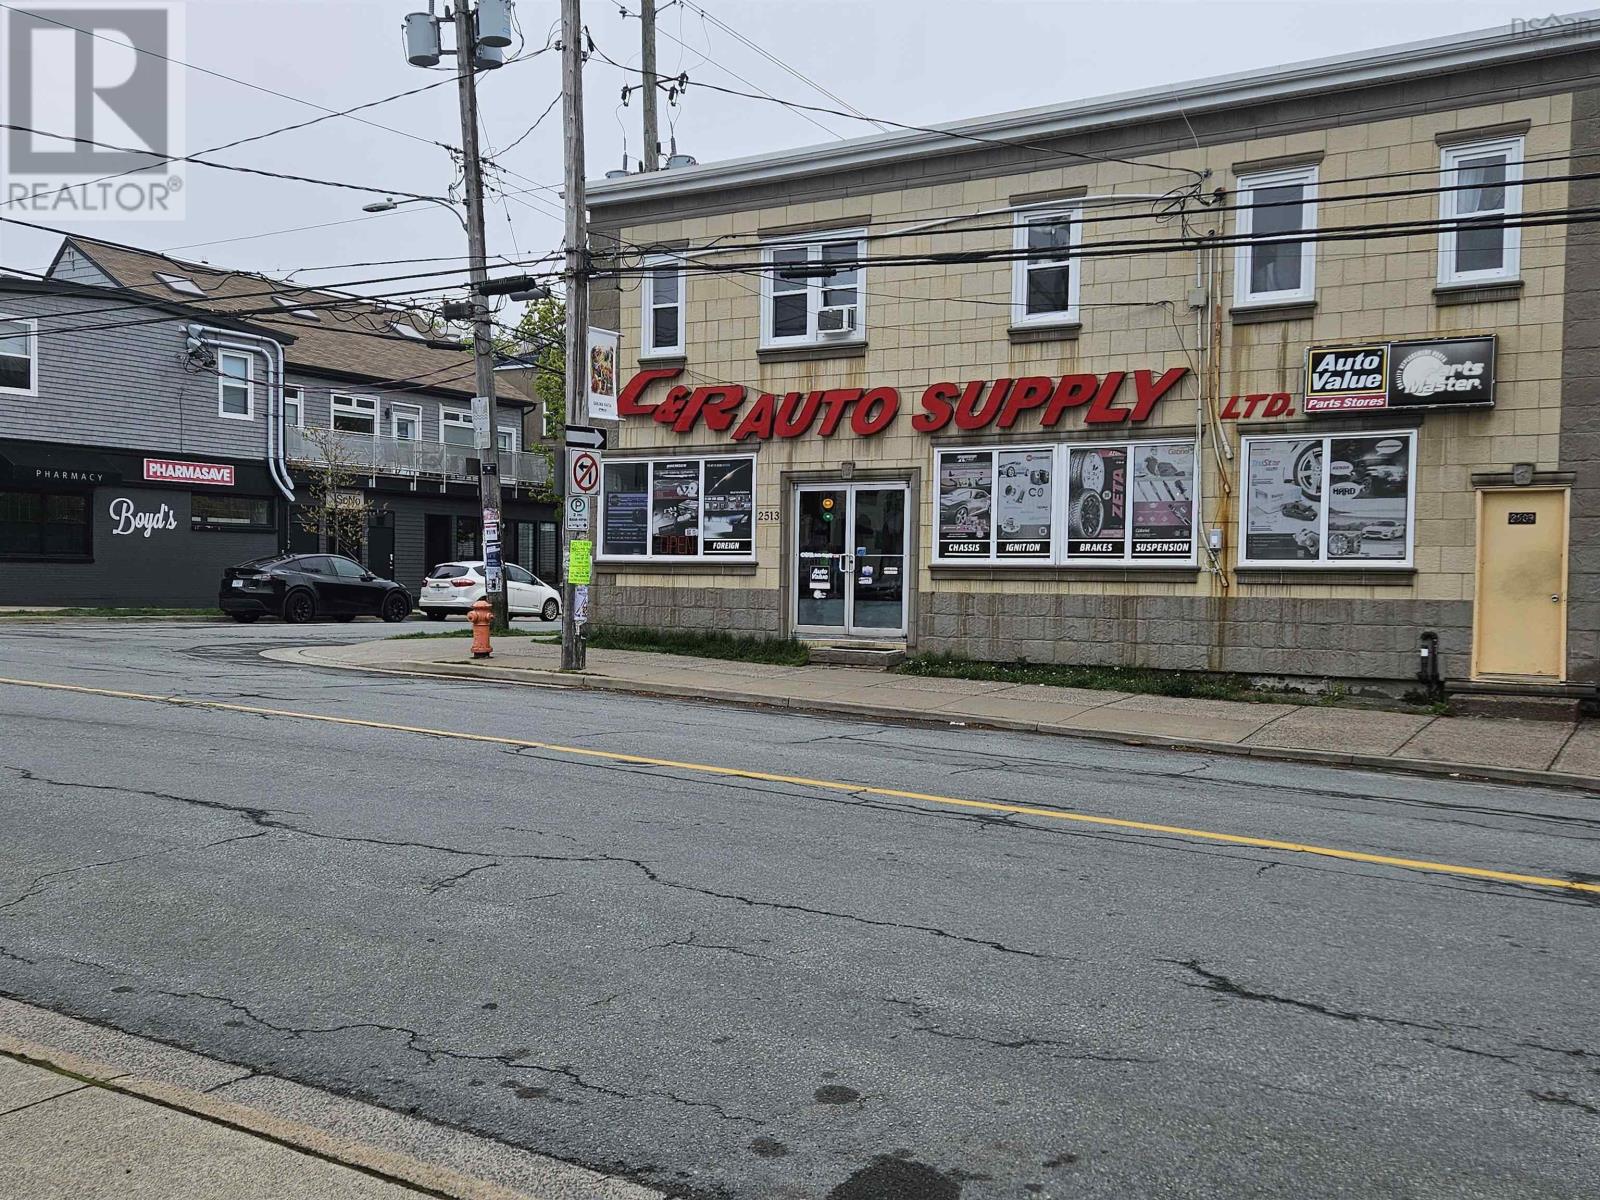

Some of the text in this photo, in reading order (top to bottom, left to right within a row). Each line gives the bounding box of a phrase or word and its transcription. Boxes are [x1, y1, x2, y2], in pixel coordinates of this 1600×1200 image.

[1315, 352, 1381, 372] Auto
[1312, 371, 1383, 391] Value
[1404, 376, 1481, 394] Master
[617, 366, 1296, 441] C&R AUTO SUPPLY LTD.
[1307, 397, 1385, 409] Parts Stores
[36, 469, 104, 482] PHARMACY
[148, 462, 231, 482] PHARMASAVE
[1112, 468, 1125, 520] ZETA
[109, 497, 178, 538] Boyd's
[758, 510, 780, 522] 2513
[712, 541, 740, 550] FOREIGN
[948, 543, 980, 552] CHASSIS
[1005, 543, 1041, 552] IGNITION
[1079, 543, 1113, 552] BRAKES
[1135, 542, 1190, 552] SUSPENSION
